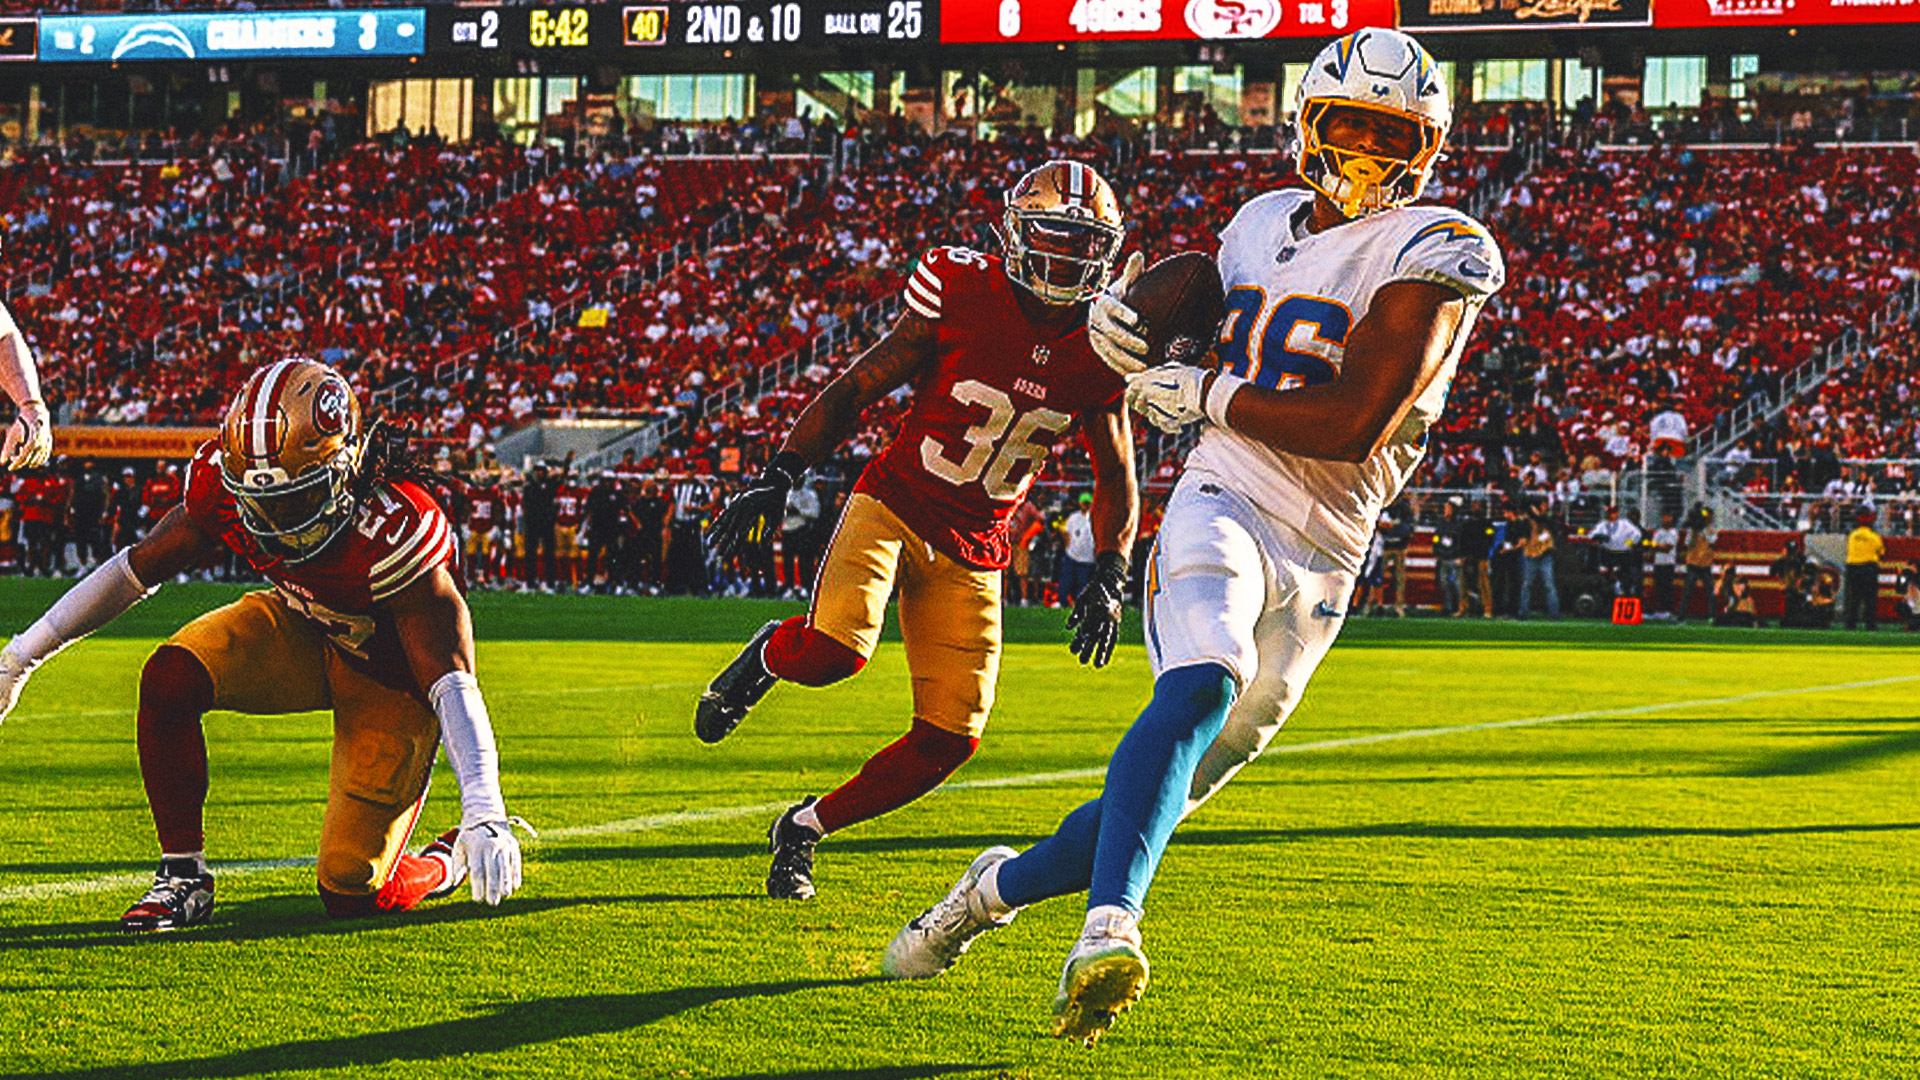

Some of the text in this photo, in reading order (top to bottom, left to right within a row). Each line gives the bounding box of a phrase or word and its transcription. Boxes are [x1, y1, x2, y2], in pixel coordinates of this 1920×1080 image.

[481, 10, 498, 48] 2
[530, 8, 588, 46] 5:42
[631, 11, 659, 41] 40
[686, 3, 800, 43] 2ND & 10
[887, 1, 922, 39] 25
[920, 379, 1072, 500] 36
[1618, 601, 1635, 619] 10
